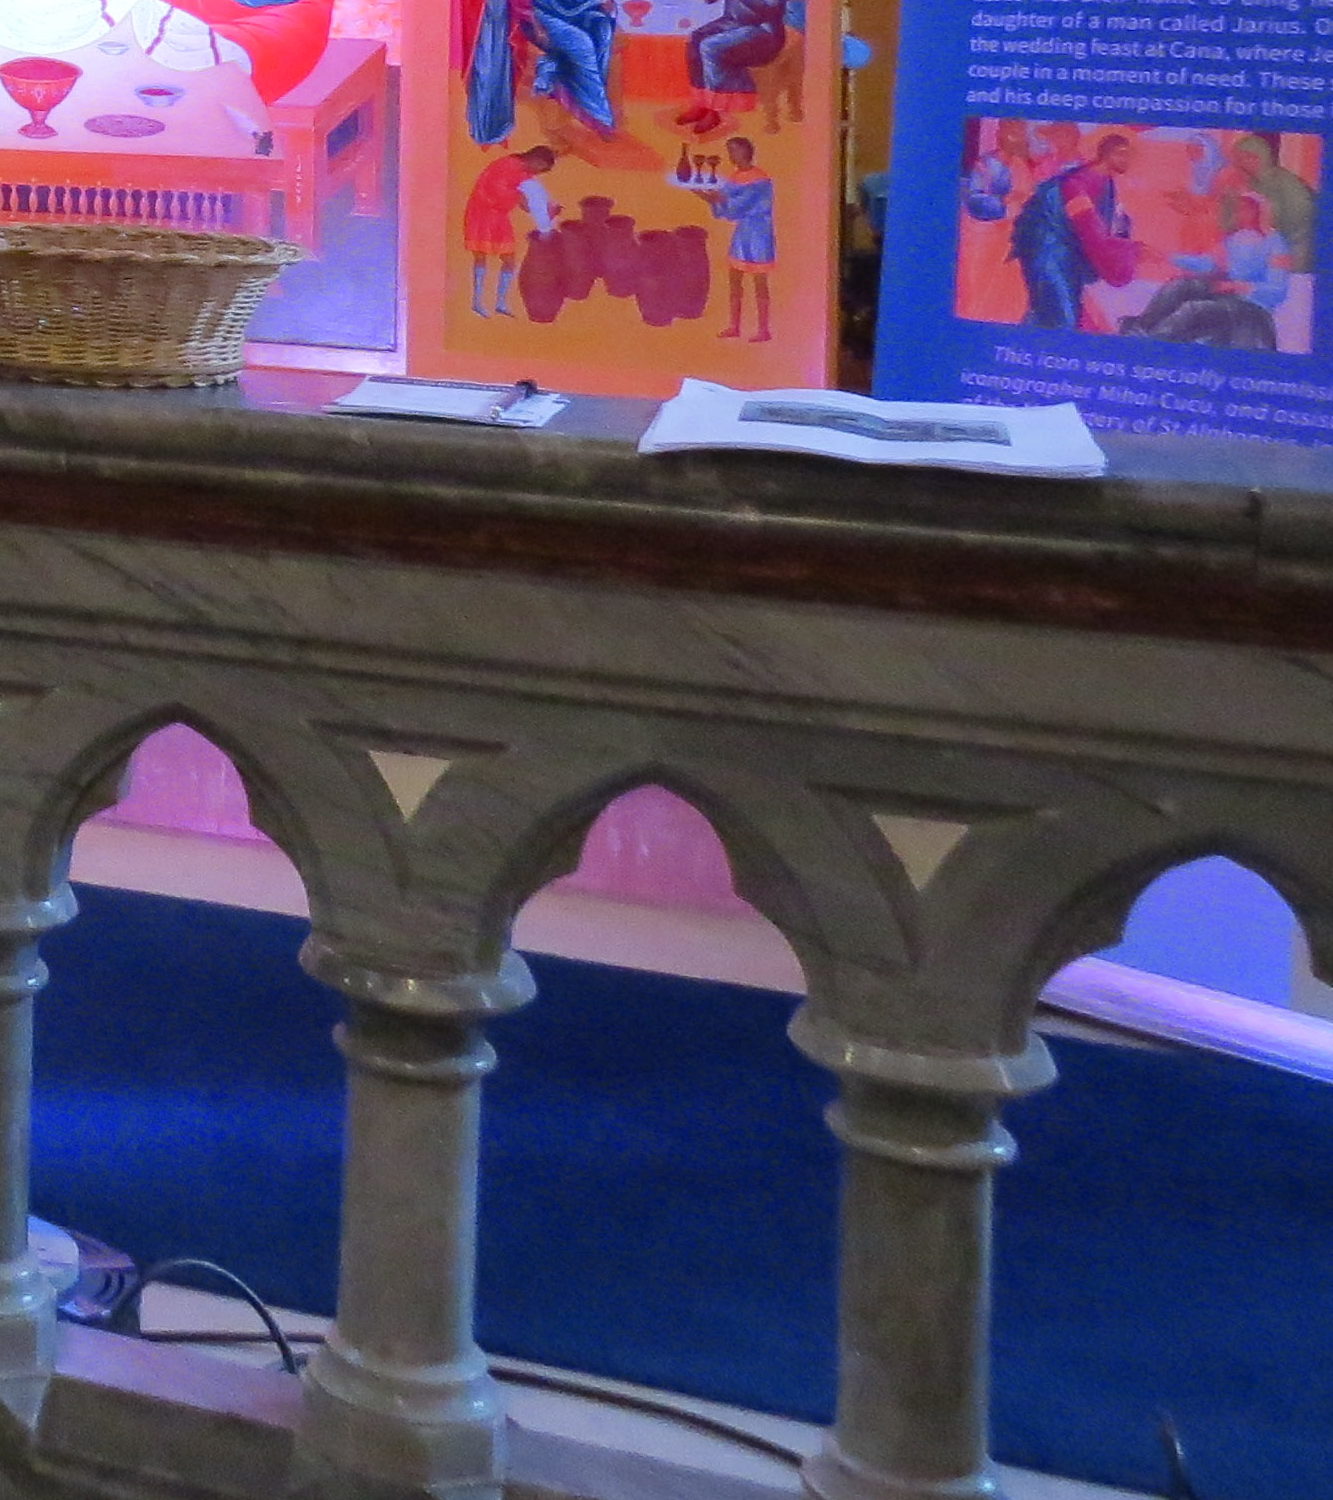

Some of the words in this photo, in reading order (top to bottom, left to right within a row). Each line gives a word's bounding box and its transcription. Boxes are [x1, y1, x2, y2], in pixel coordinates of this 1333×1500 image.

[971, 12, 1056, 31] daughter
[1062, 12, 1083, 28] of
[1107, 15, 1152, 31] man
[1160, 15, 1225, 33] called
[970, 38, 999, 53] the
[1003, 40, 1087, 59] wedding
[1090, 39, 1140, 56] feast
[1145, 43, 1165, 58] at
[1236, 44, 1304, 62] where
[968, 64, 1031, 81] couple
[1034, 63, 1053, 80] in
[1073, 66, 1161, 84] moment
[1167, 66, 1187, 85] of
[1191, 71, 1250, 88] need.
[1259, 71, 1325, 91] These
[966, 88, 1001, 104] and
[1005, 88, 1032, 106] his
[1037, 91, 1087, 109] deep
[1093, 91, 1220, 113] compassion
[1226, 95, 1254, 115] for
[1261, 97, 1324, 119] those
